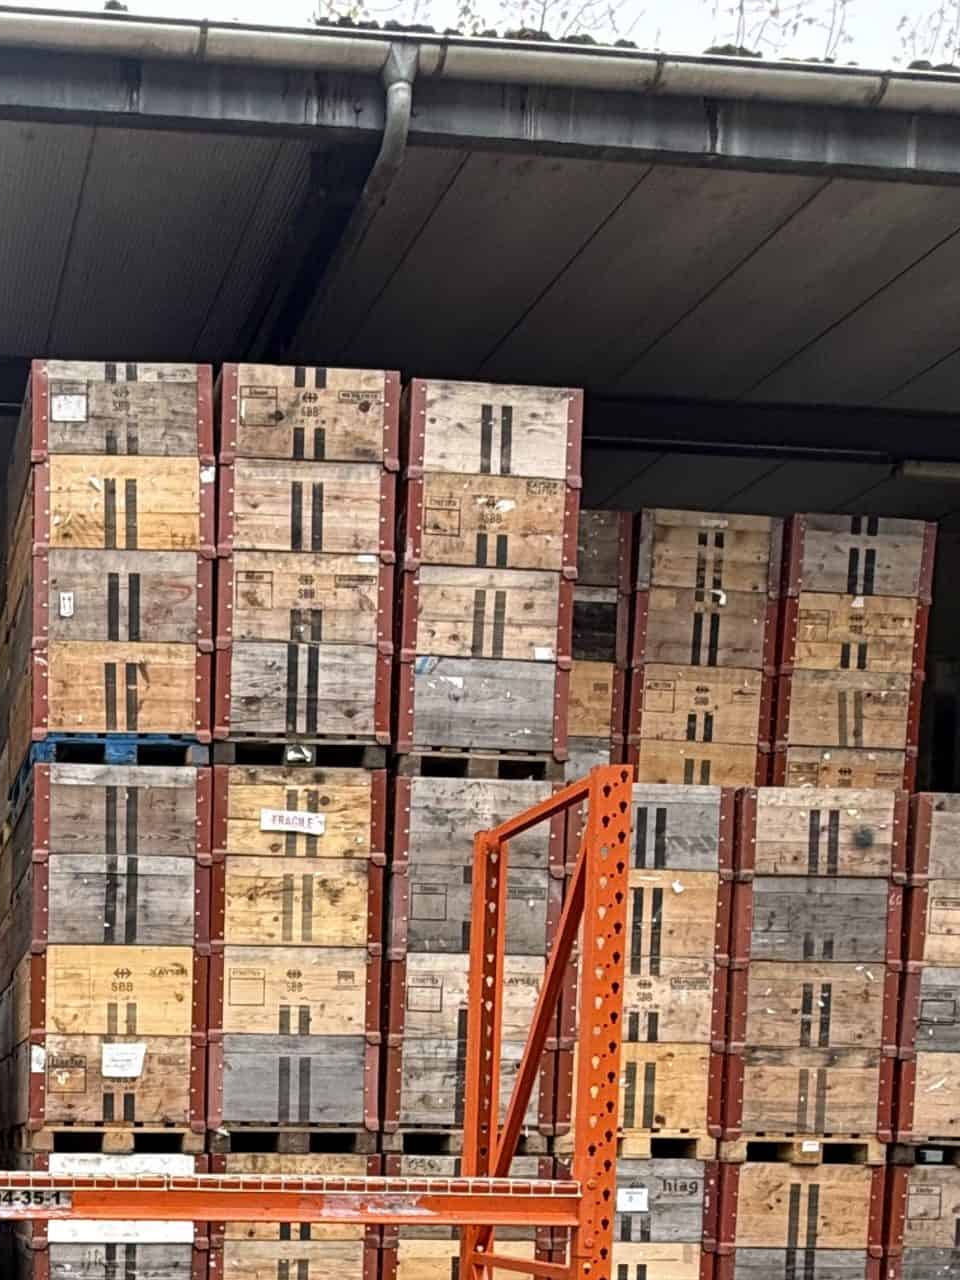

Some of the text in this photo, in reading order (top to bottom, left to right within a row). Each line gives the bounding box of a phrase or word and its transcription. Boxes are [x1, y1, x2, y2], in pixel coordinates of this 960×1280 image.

[271, 814, 314, 830] FRAGILE
[111, 982, 134, 993] SBB
[662, 1178, 699, 1195] hiag
